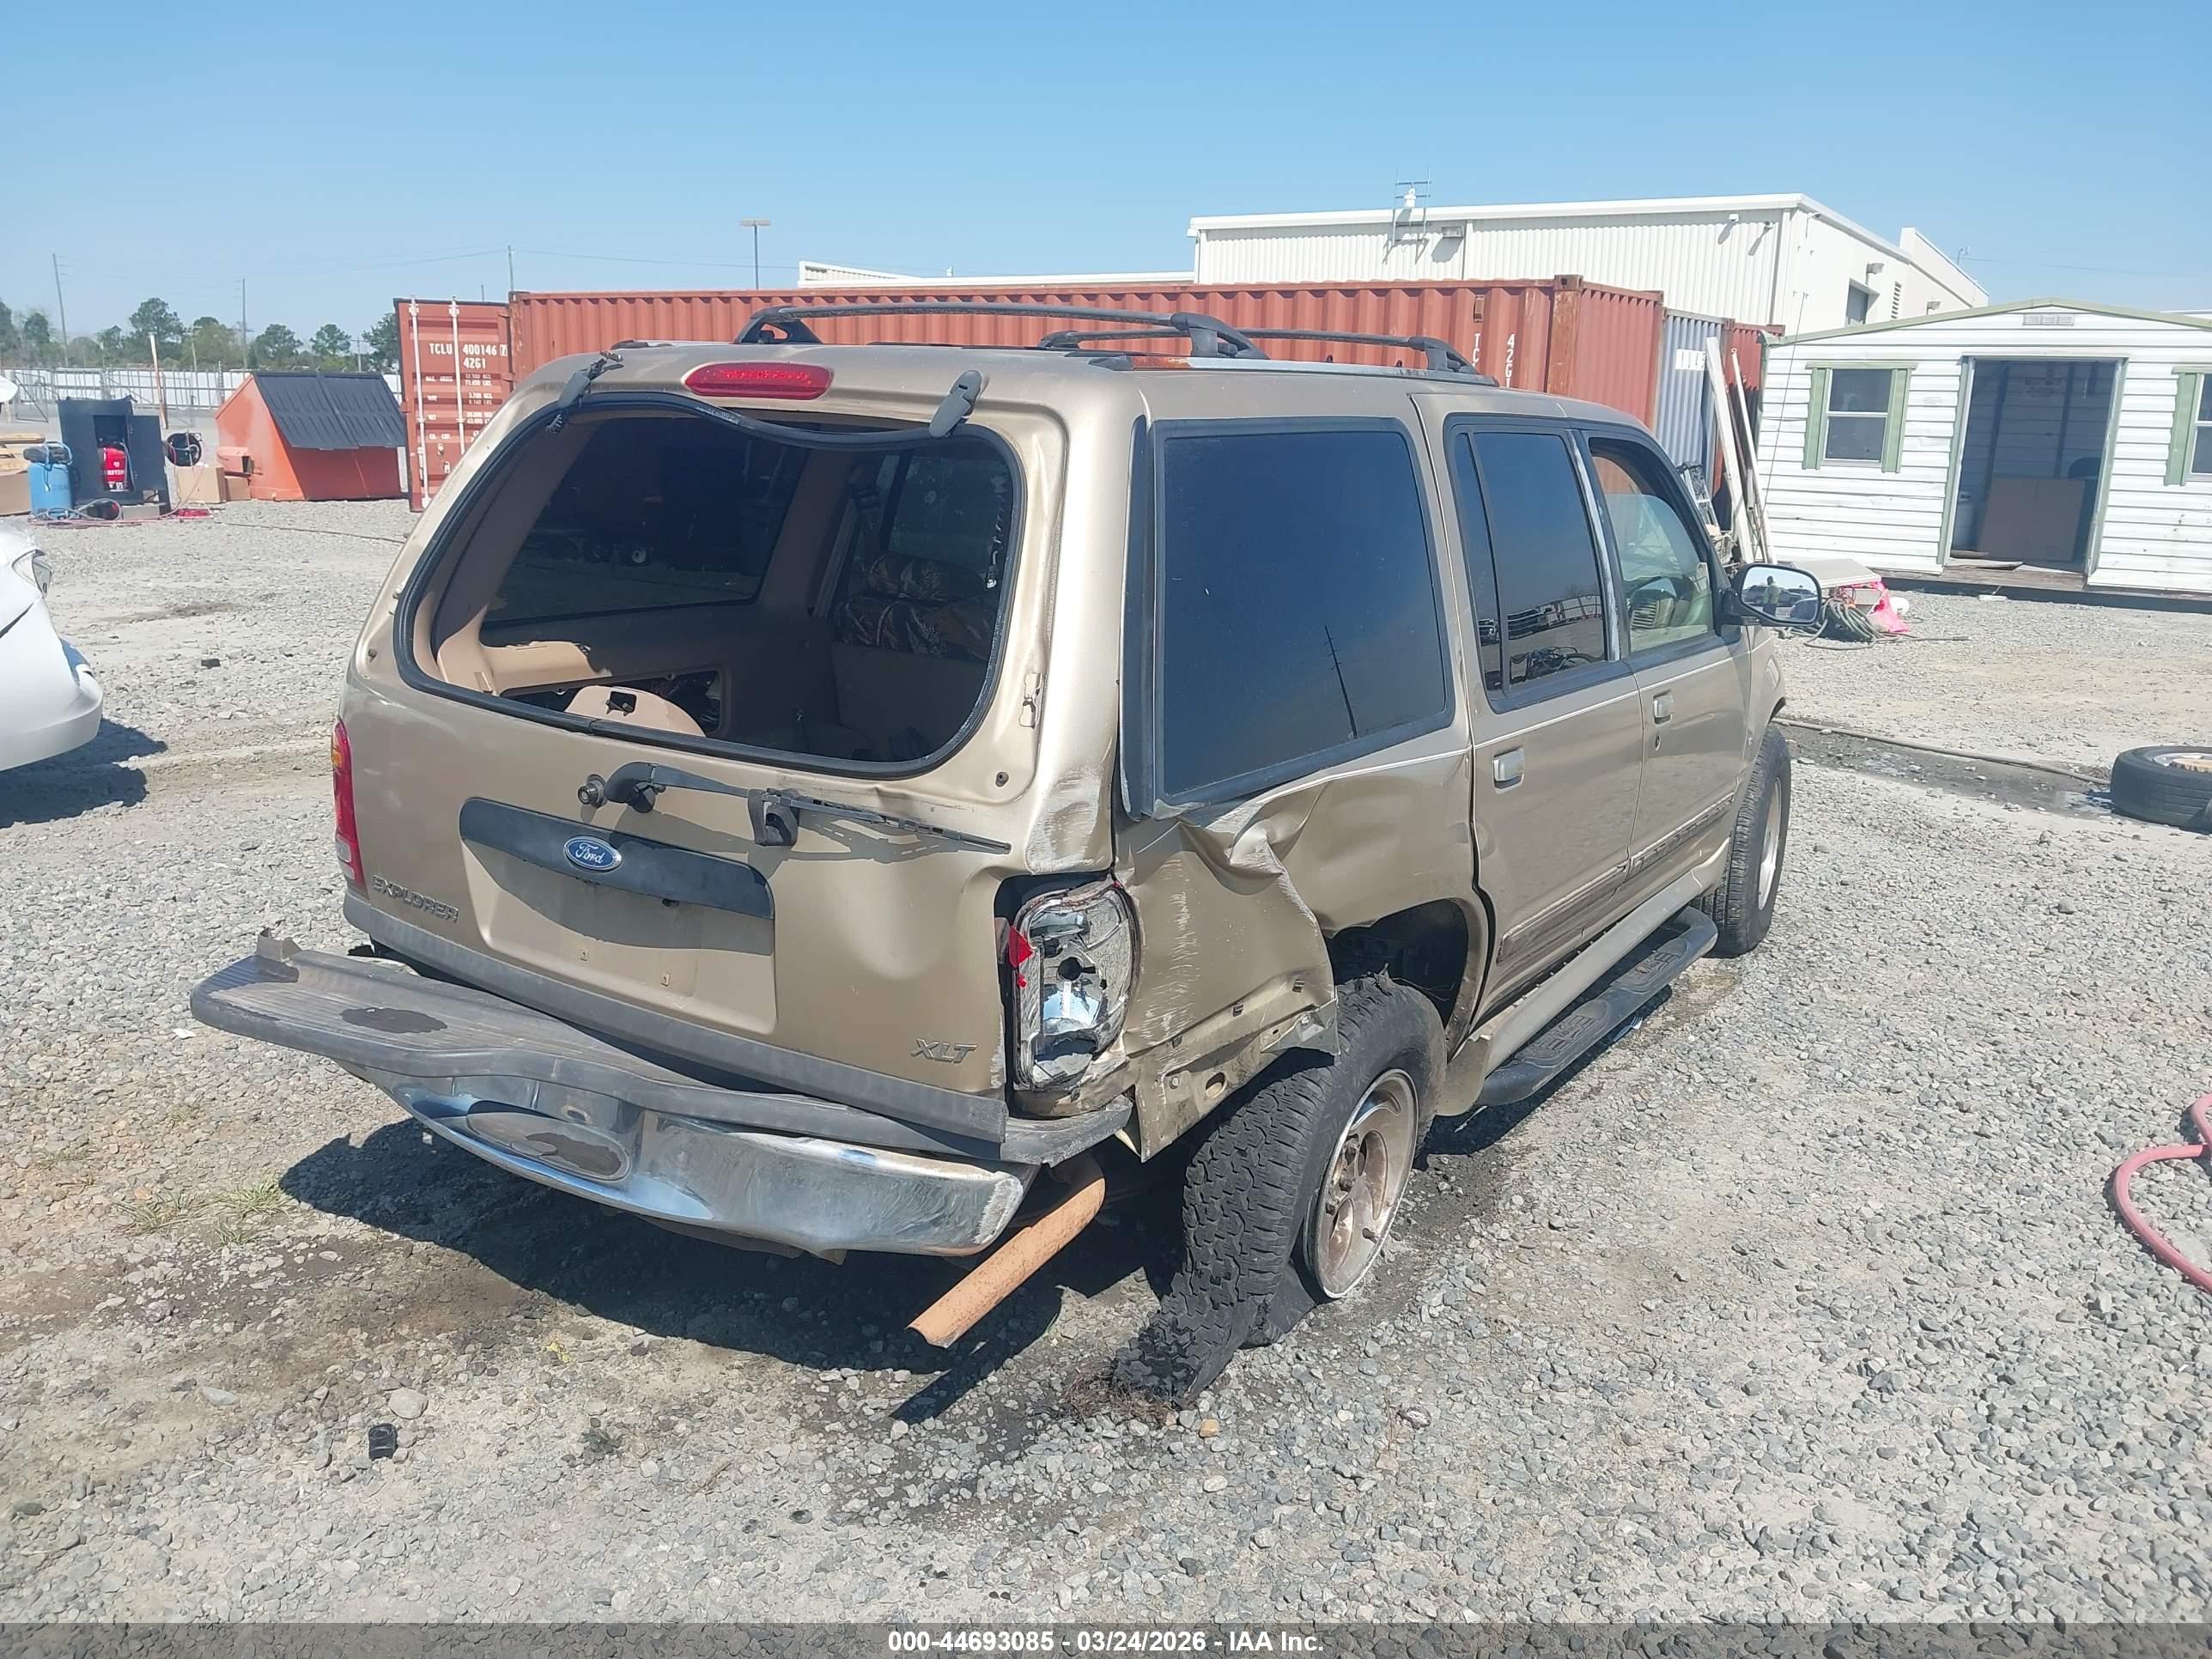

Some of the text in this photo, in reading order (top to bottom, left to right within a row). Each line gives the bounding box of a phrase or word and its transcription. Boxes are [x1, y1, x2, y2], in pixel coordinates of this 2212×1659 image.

[429, 343, 453, 355] TCLU
[462, 343, 497, 356] 400146
[575, 842, 605, 864] Ford
[372, 874, 459, 924] EXPLORER
[910, 1038, 977, 1064] XLT
